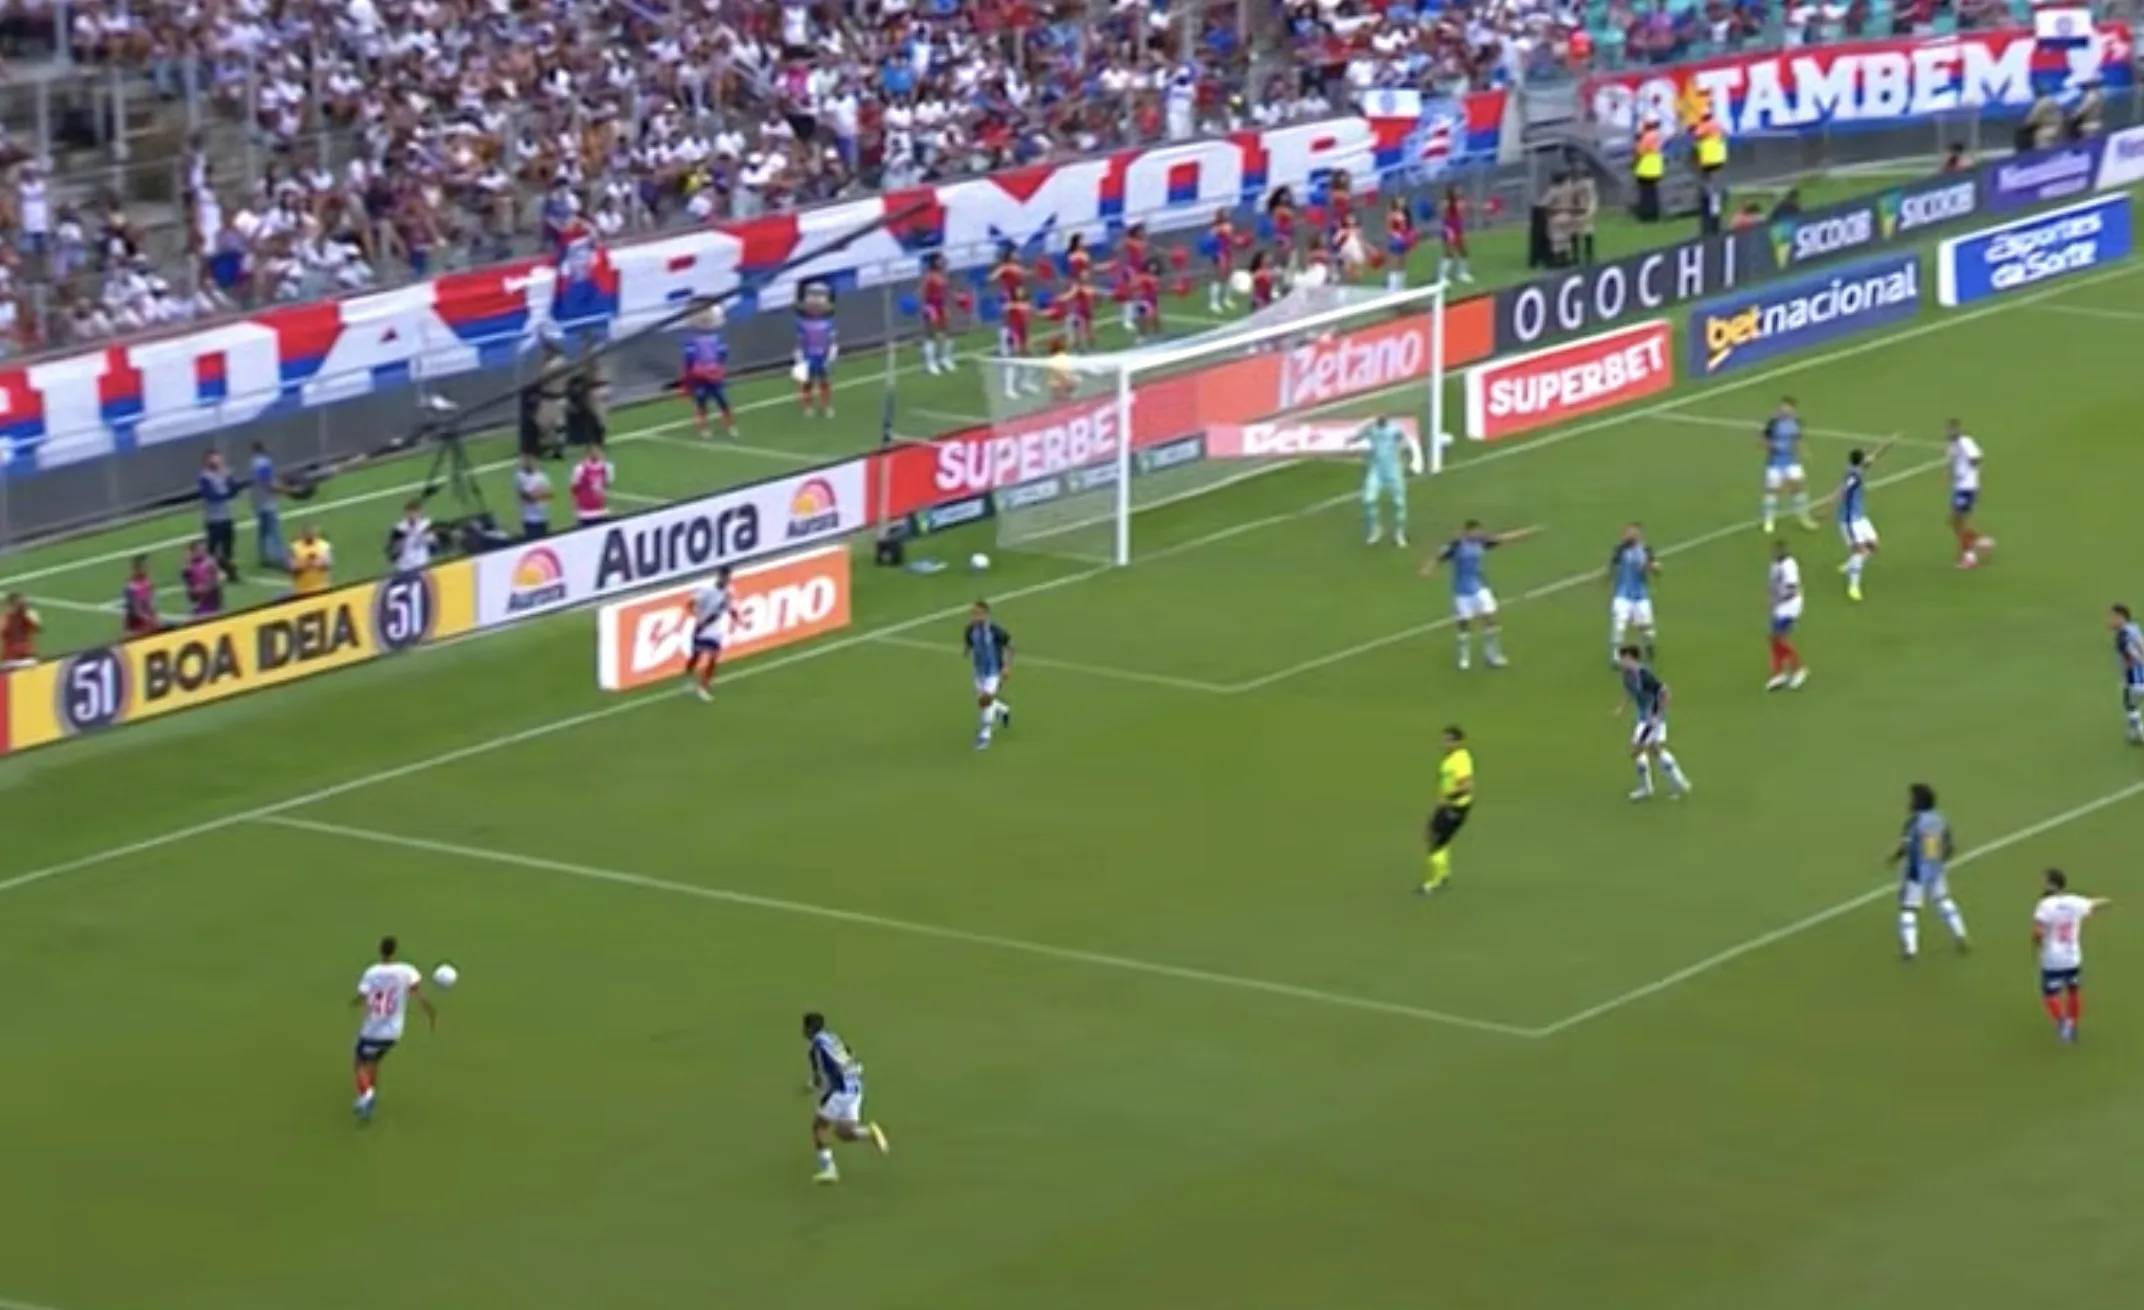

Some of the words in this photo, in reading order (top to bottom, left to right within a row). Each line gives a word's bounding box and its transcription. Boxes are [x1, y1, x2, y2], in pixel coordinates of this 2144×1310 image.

[1513, 235, 1736, 342] OGOCHI
[1705, 261, 1919, 358] betnacional
[0, 281, 480, 469] IDA
[1488, 333, 1666, 417] SUPERBET
[934, 403, 1137, 491] SUPERBE
[595, 502, 760, 590] Aurora
[783, 511, 839, 540] Aurora
[386, 580, 424, 643] 51
[505, 581, 568, 613] Aurora
[631, 575, 837, 674] Bano
[71, 658, 117, 724] 51
[142, 633, 241, 701] BOA
[256, 603, 360, 673] IDEIA
